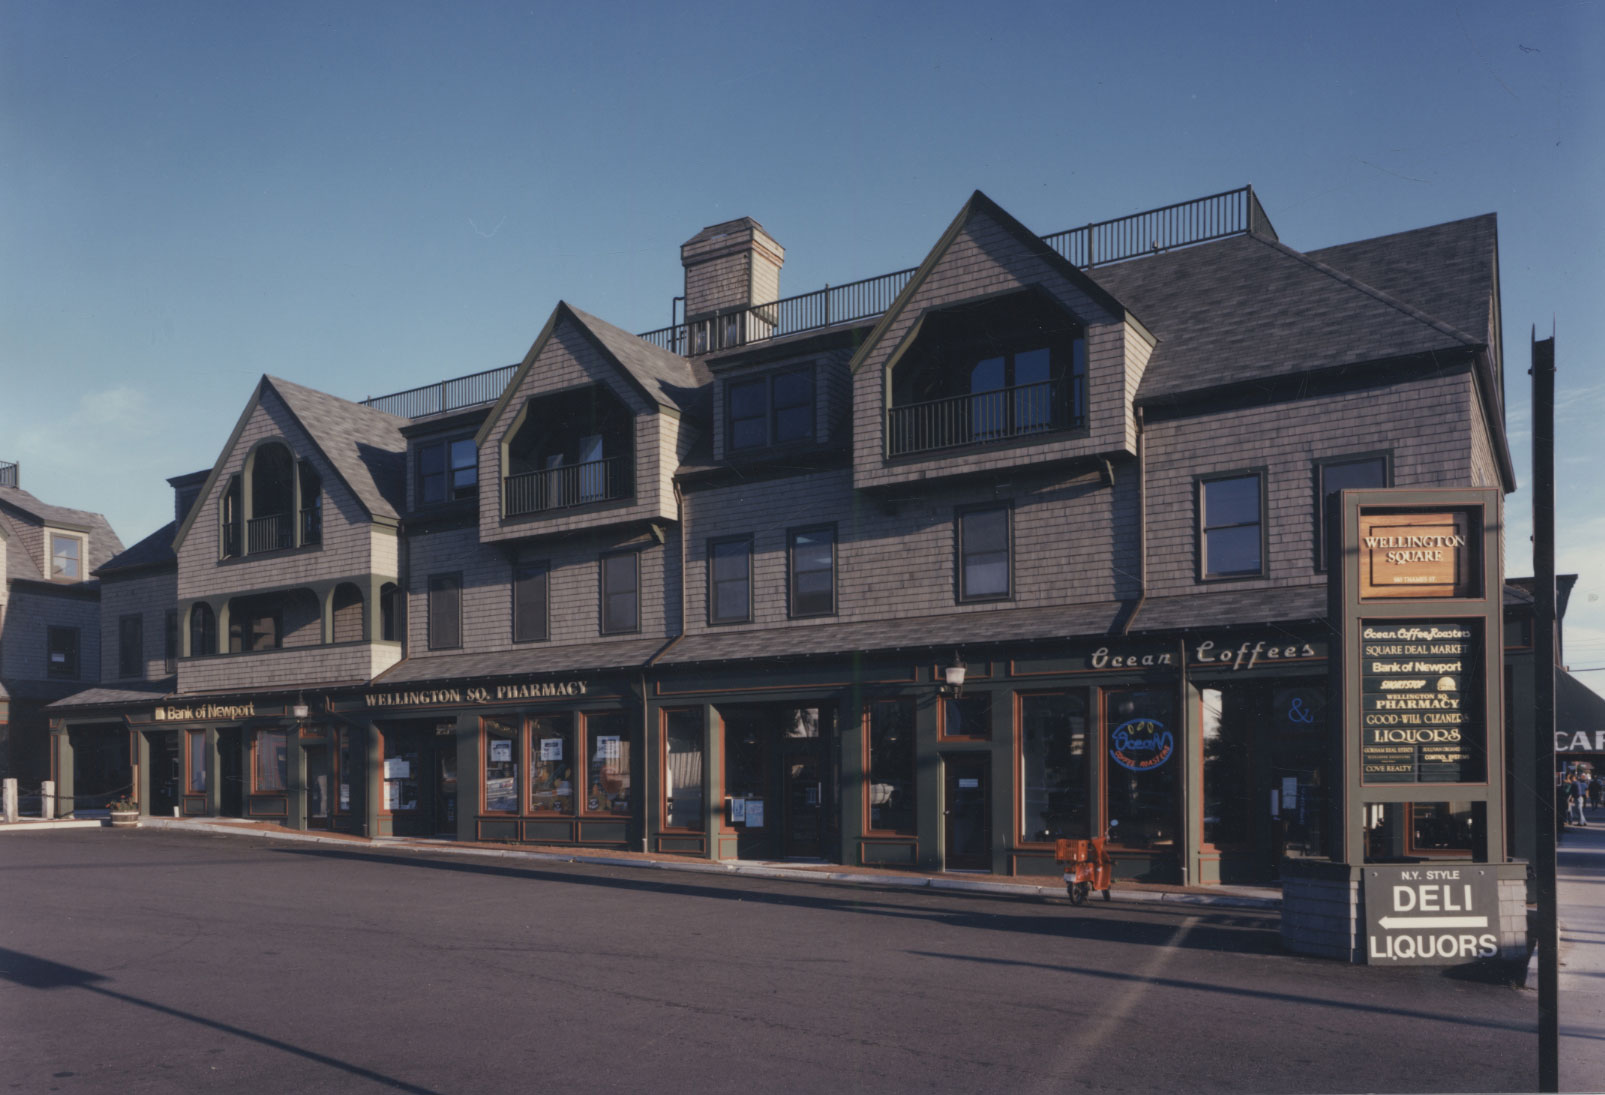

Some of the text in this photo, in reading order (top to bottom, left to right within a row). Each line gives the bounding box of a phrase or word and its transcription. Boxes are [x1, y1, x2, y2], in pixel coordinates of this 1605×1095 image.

[1364, 535, 1466, 549] WELLINGTON
[1387, 550, 1444, 565] SQUARE
[1363, 628, 1396, 639] Ocean
[1428, 628, 1471, 640] Roasters
[1091, 641, 1315, 670] Ocean Coffees
[1366, 645, 1469, 656] SQUARE DEAL MARKET
[1372, 662, 1462, 673] Bank of Newport
[365, 681, 587, 706] WELLINGTON SQ. PHARMACY
[167, 701, 255, 720] Bank of Newport
[1288, 698, 1314, 723] &
[1376, 700, 1460, 709] PHARMACY
[1366, 714, 1421, 724] GOOD-WILL
[1374, 729, 1461, 743] LIQUORS
[1402, 870, 1460, 880] N.Y. STYLE
[1393, 884, 1472, 912] DELI
[1370, 934, 1497, 959] LIQUORS
